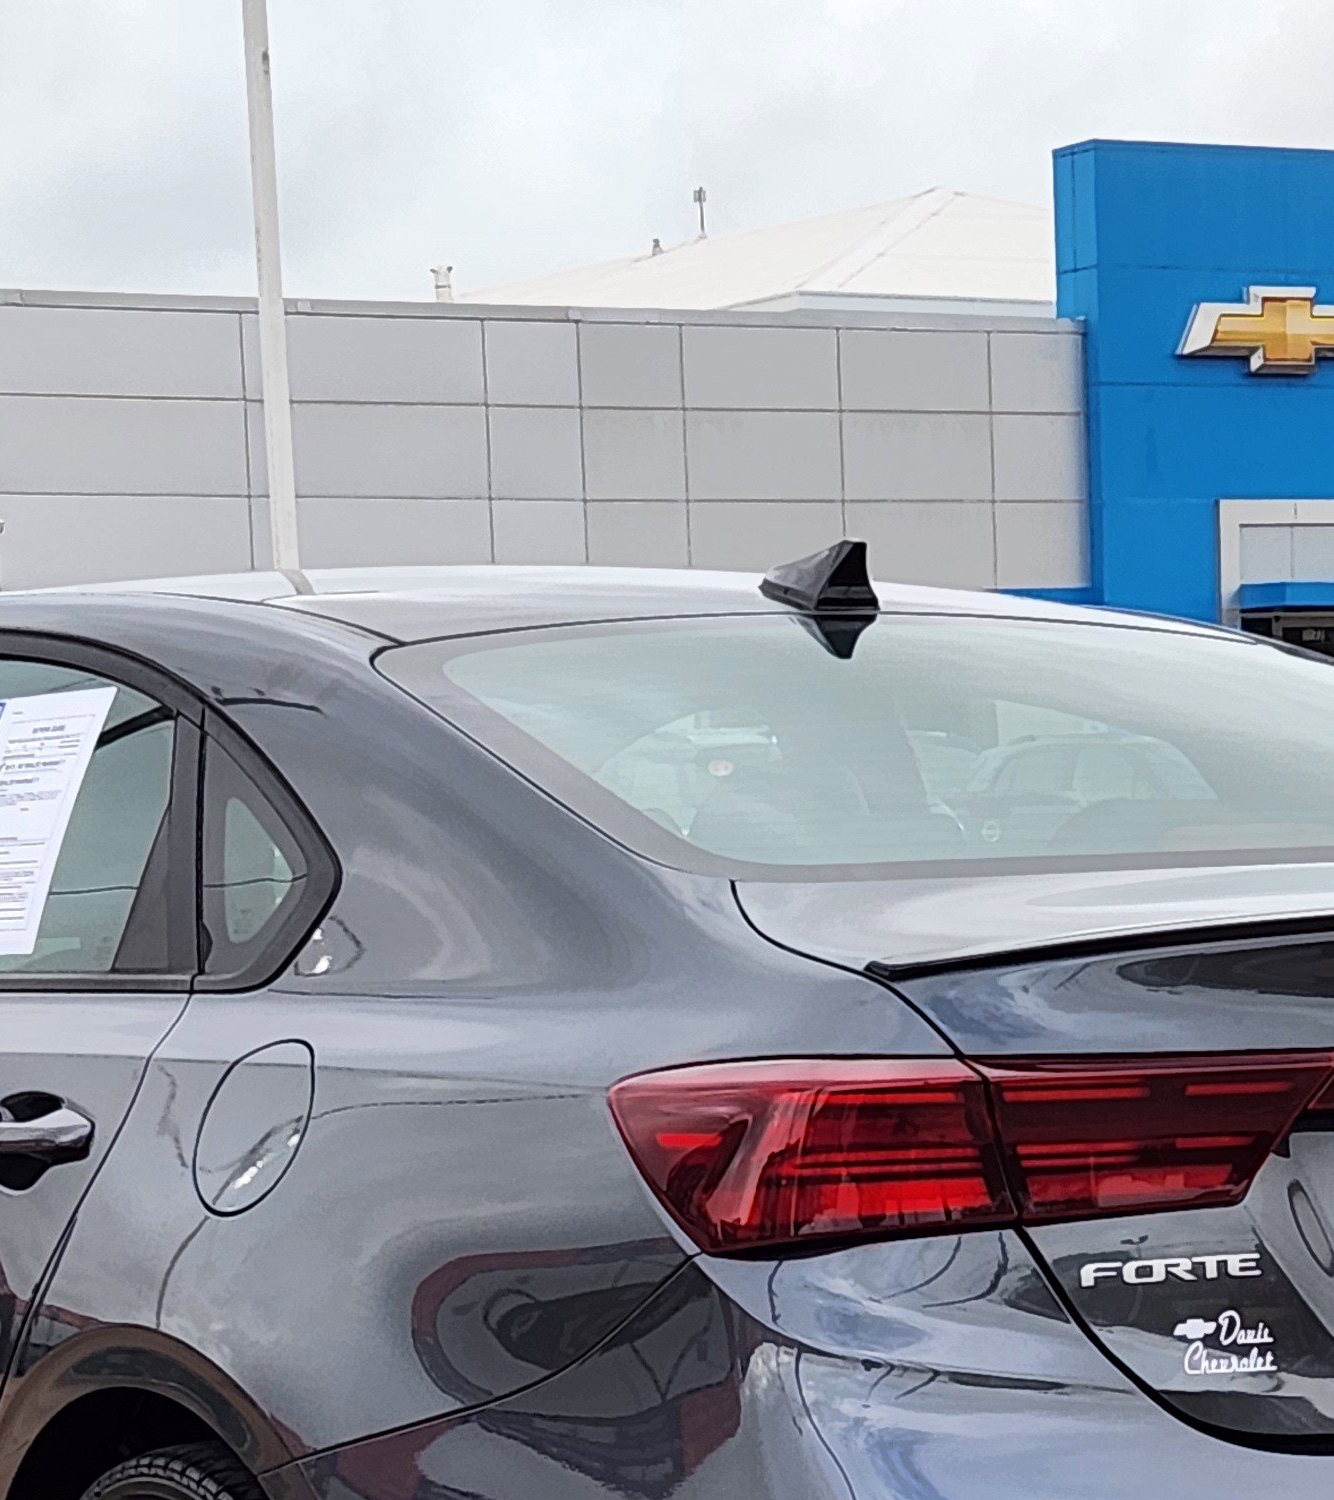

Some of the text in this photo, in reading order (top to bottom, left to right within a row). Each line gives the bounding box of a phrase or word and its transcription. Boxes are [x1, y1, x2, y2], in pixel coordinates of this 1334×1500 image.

[1080, 1253, 1263, 1287] FORTE
[1217, 1310, 1275, 1346] Davis
[1183, 1340, 1278, 1375] Chevrolet
